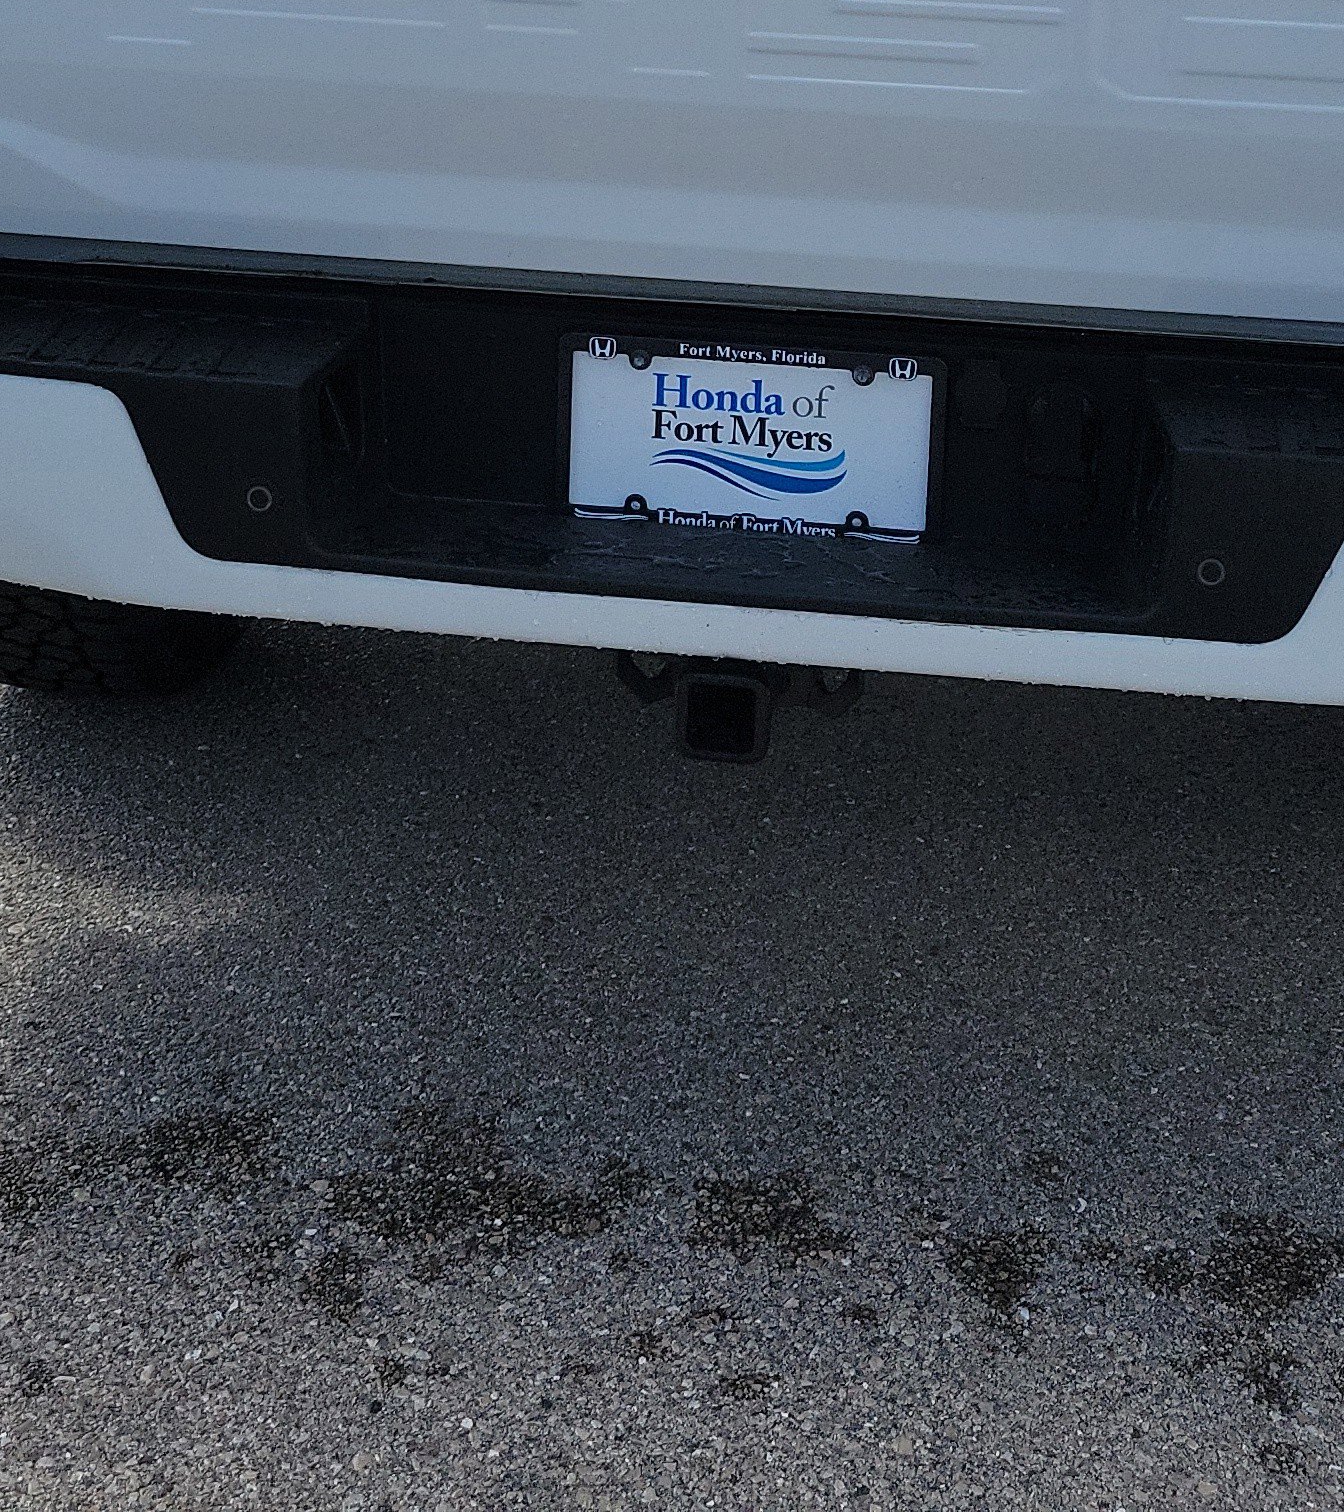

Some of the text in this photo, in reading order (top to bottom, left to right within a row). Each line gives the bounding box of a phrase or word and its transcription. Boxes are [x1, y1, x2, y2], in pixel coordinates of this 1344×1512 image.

[678, 342, 712, 358] Fort
[771, 348, 827, 366] Florida
[652, 372, 836, 419] Honda of
[651, 409, 833, 458] Fort Myers
[657, 508, 717, 528] Honda
[719, 513, 737, 530] of
[741, 515, 780, 533] Fort
